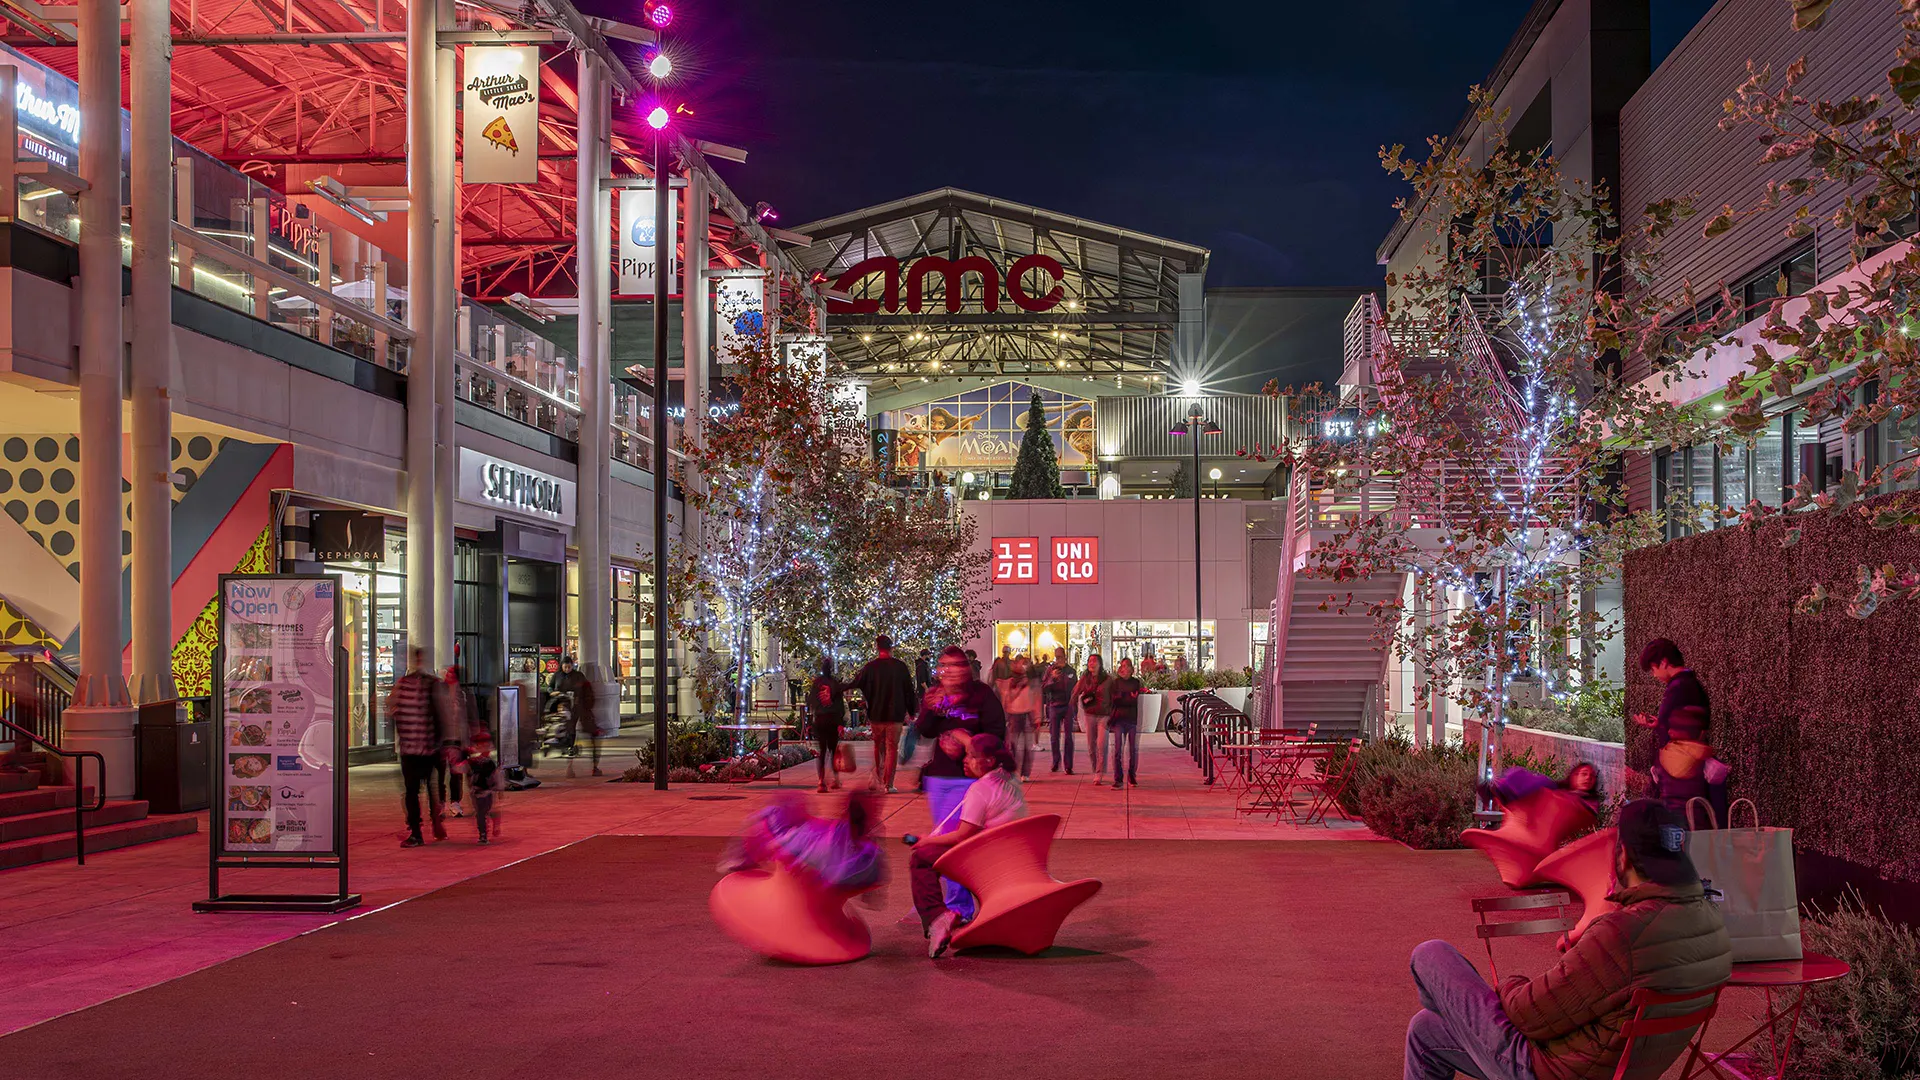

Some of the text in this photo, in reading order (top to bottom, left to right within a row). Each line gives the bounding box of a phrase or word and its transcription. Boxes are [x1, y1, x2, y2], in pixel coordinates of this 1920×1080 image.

[467, 74, 514, 91] Arthur
[483, 87, 504, 96] LITTLE
[492, 92, 536, 110] Mac's
[622, 258, 674, 279] Pippl
[826, 253, 1065, 314] amc
[960, 437, 1021, 455] MOAN
[485, 462, 563, 515] SEPHORA
[318, 551, 379, 560] SEPHORA
[1056, 543, 1090, 559] UNI
[1056, 561, 1094, 581] QLO
[231, 584, 272, 598] Now
[231, 599, 279, 617] Open
[277, 623, 304, 632] FLORES
